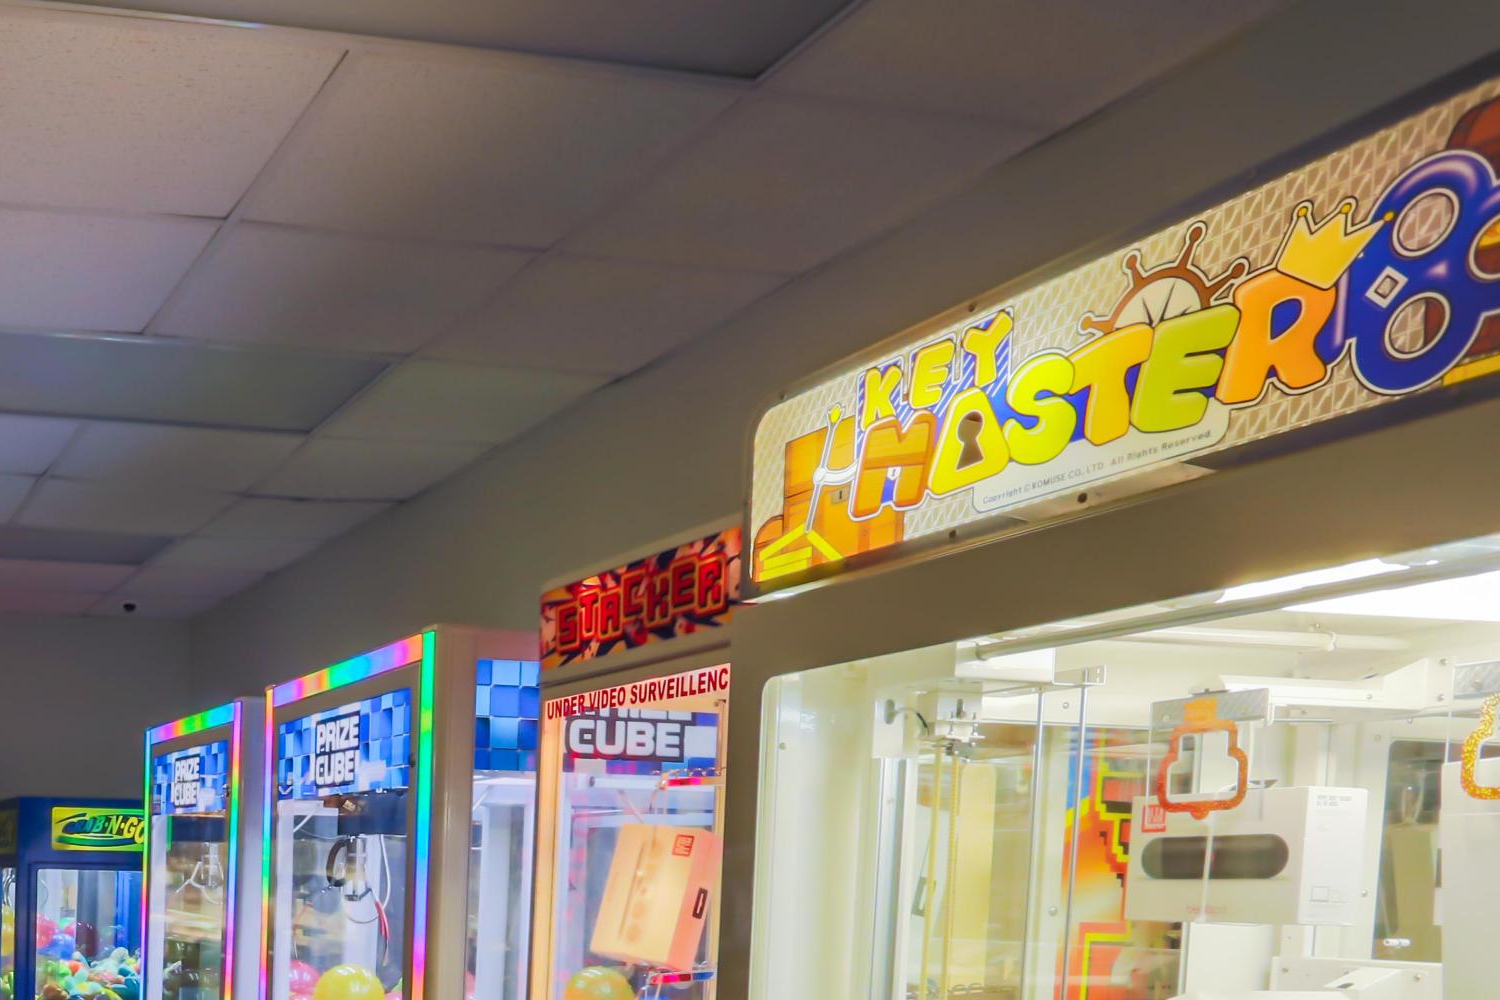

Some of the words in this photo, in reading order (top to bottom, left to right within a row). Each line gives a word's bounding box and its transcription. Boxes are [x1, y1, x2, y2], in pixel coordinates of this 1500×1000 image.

[861, 310, 1015, 432] KEY
[850, 268, 1338, 519] MASTER
[555, 552, 728, 655] STACKER
[547, 692, 585, 720] UNDER
[589, 686, 626, 711] VIDEO
[317, 715, 359, 754] PRIZE
[569, 719, 681, 758] CUBE
[175, 756, 200, 783] PRIZE
